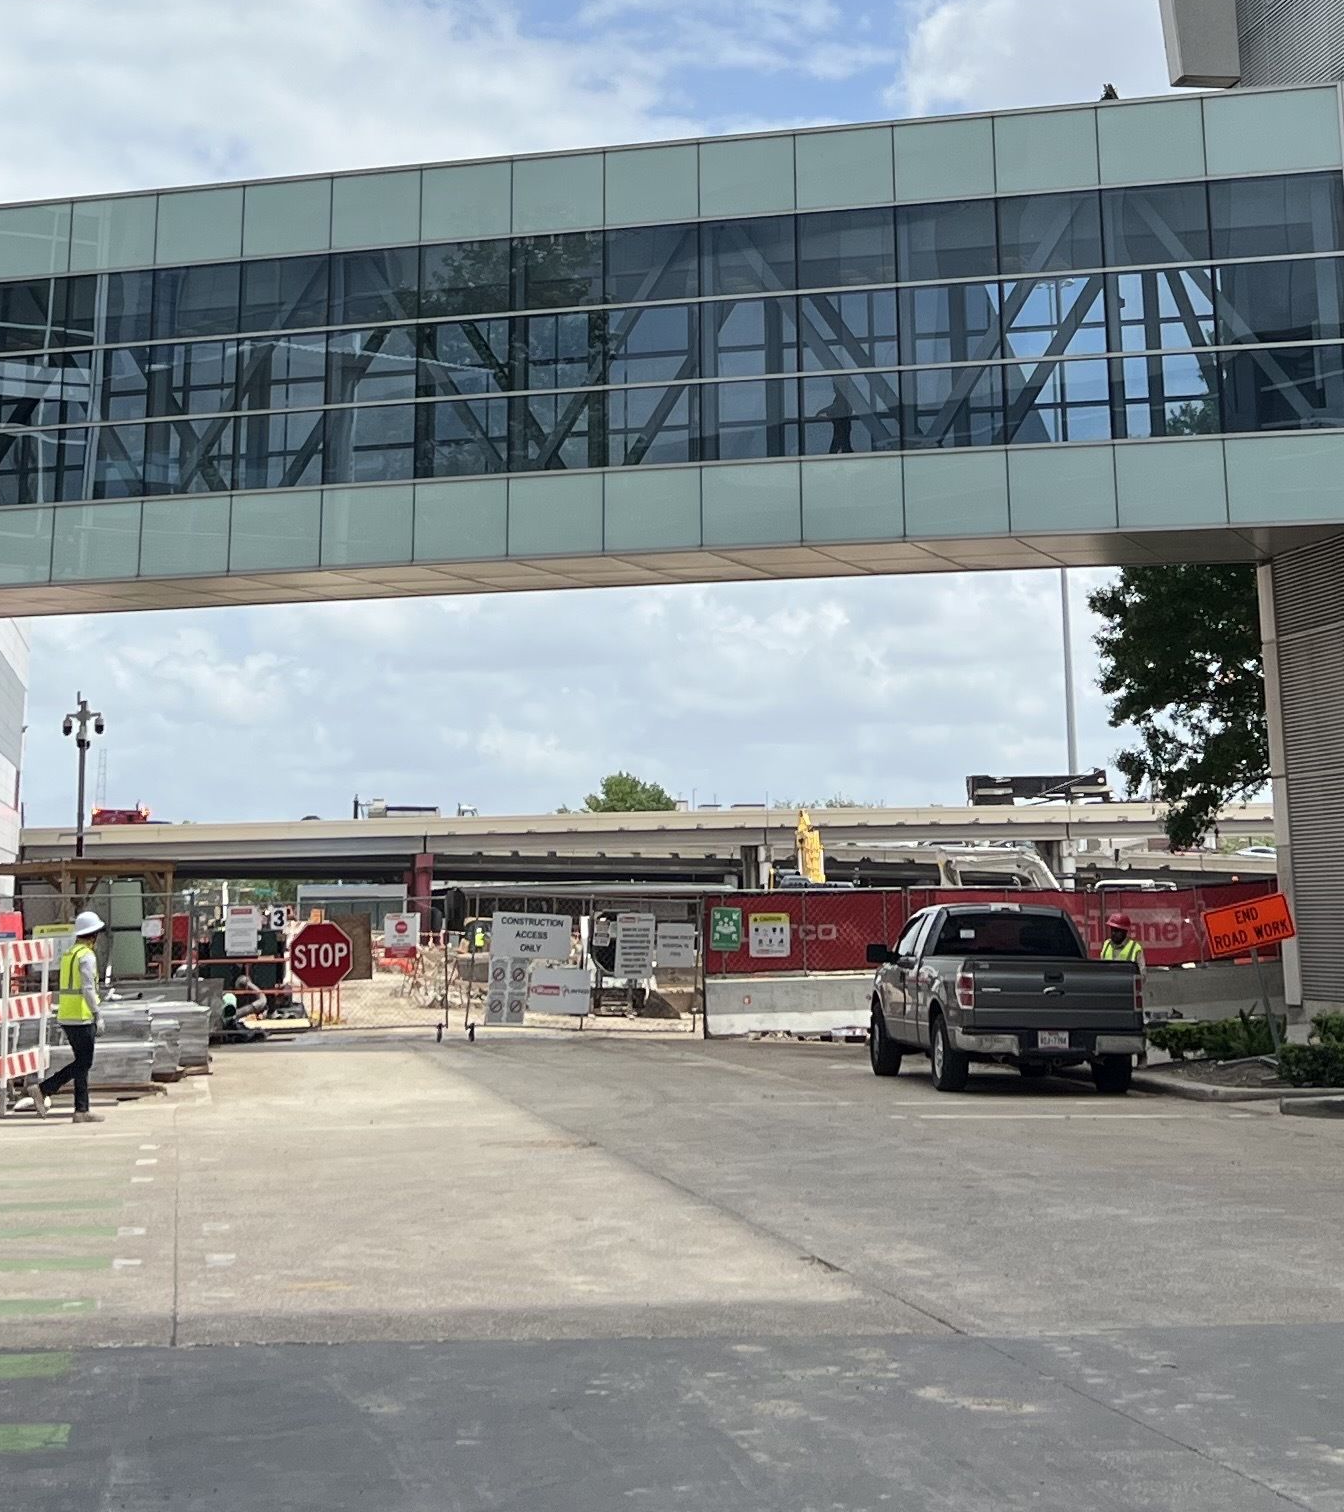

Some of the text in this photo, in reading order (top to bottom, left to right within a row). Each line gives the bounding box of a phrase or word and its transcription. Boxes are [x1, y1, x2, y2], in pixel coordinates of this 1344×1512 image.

[273, 910, 284, 927] 3
[501, 916, 564, 928] CONSTRUCTION
[1234, 906, 1259, 925] END
[514, 930, 548, 940] ACCESS
[1213, 918, 1289, 952] ROAD WORK
[294, 943, 348, 970] STOP
[519, 944, 542, 953] ONLY
